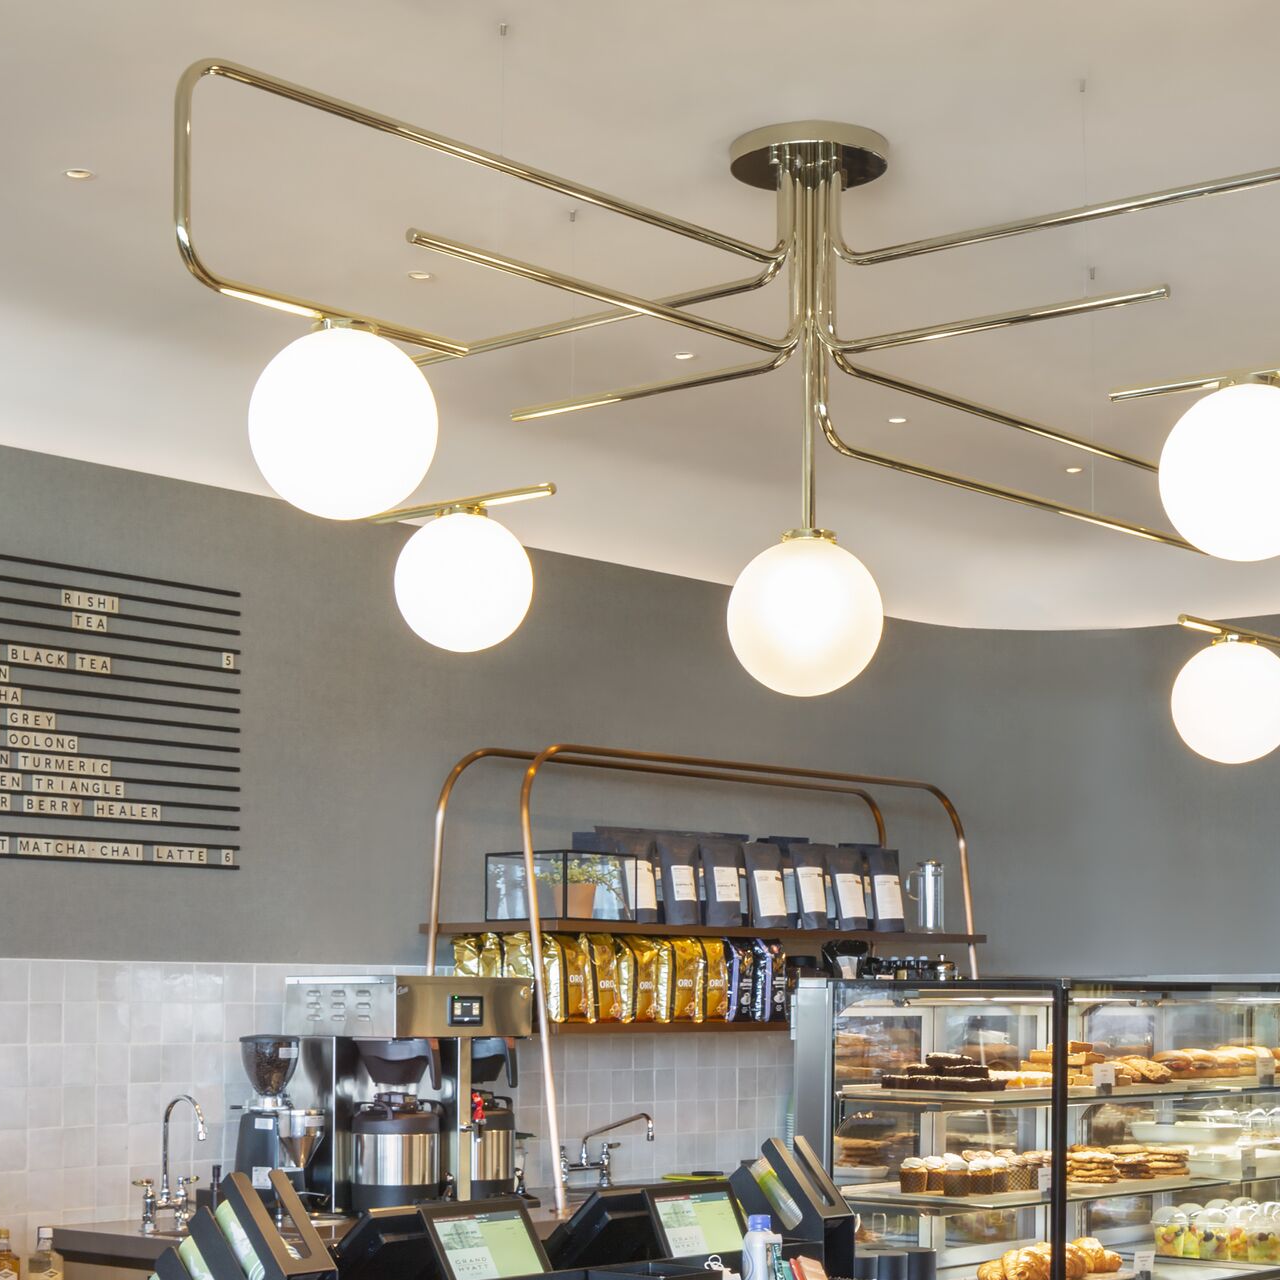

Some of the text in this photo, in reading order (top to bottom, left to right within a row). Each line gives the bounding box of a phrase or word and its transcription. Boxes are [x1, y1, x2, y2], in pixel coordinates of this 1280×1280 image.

[64, 592, 115, 612] RISHI
[74, 615, 106, 631] TEA
[10, 648, 65, 666] BLACK
[79, 656, 110, 672] TEA
[225, 655, 232, 667] 5
[9, 712, 54, 728] GREY
[9, 733, 77, 751] OOLONG
[21, 755, 109, 775] TURMERIC
[35, 777, 122, 797] TRIANGLE
[26, 800, 81, 814] BERRY
[96, 804, 159, 819] HEALER
[156, 847, 206, 862] LATTE
[224, 852, 231, 864] 6
[570, 974, 584, 984] ORO
[600, 980, 614, 989] ORO
[640, 981, 653, 990] ORO
[678, 979, 692, 988] ORO
[710, 979, 724, 988] ORO
